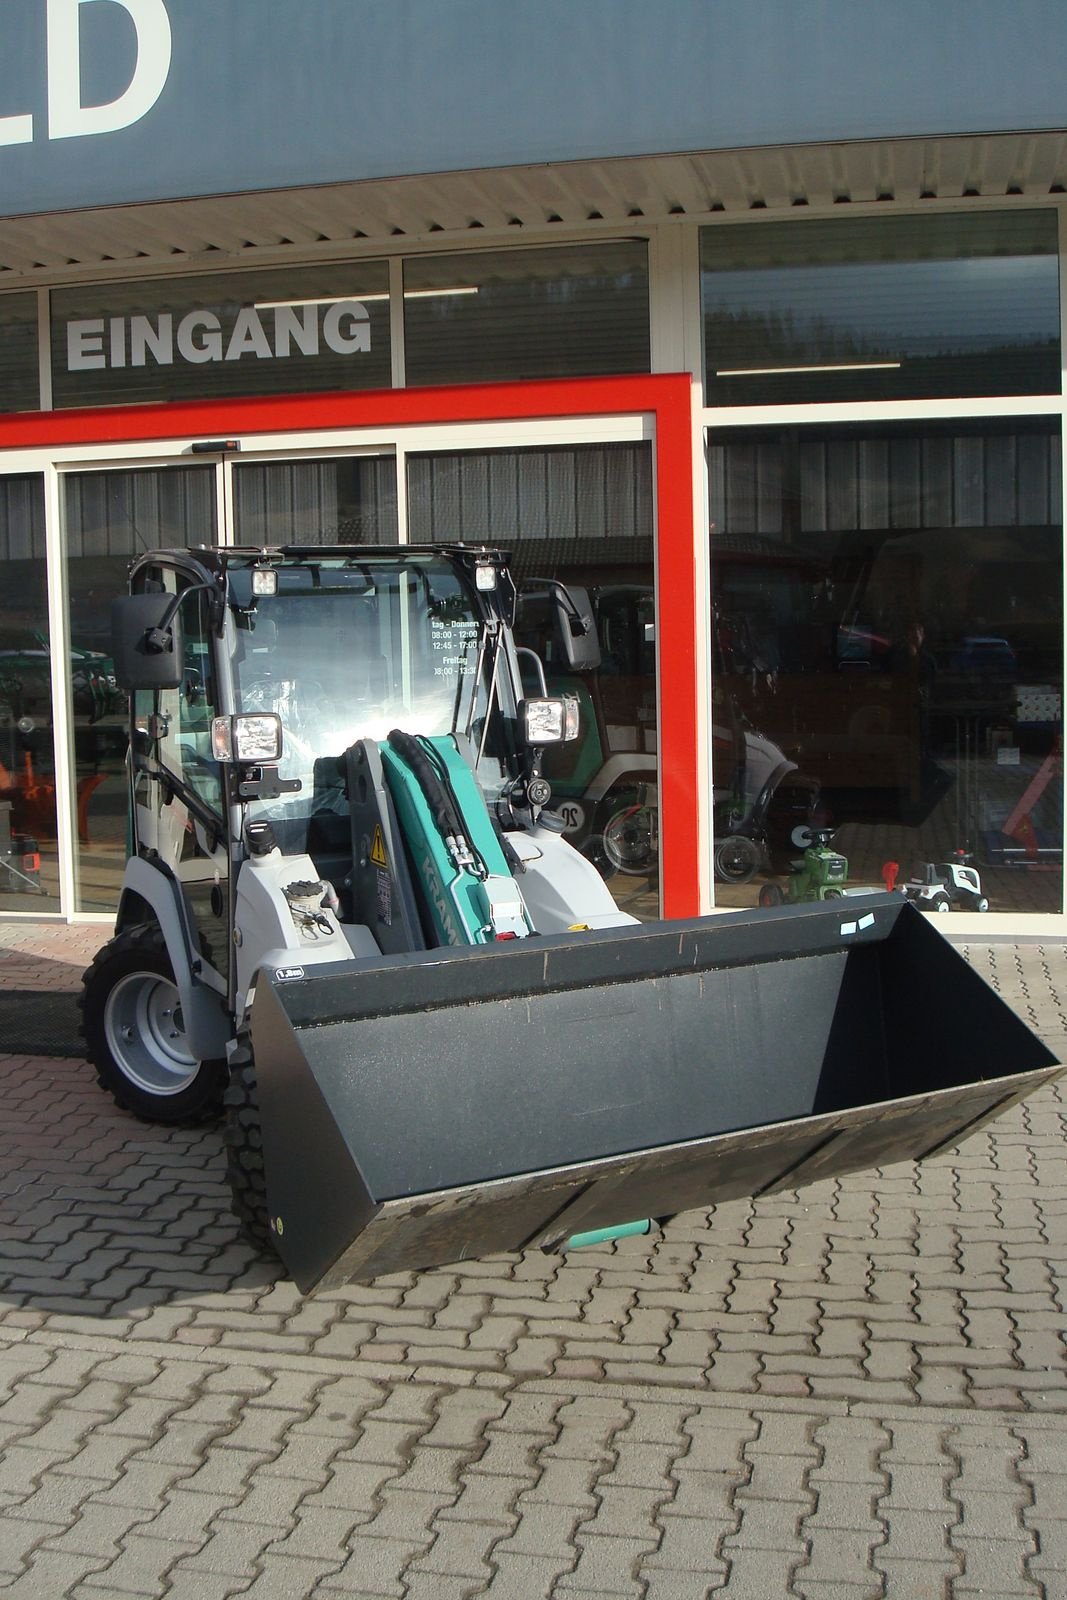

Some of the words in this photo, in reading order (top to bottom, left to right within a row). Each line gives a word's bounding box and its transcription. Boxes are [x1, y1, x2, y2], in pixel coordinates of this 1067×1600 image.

[0, 0, 172, 146] D
[67, 300, 371, 371] EINGANG
[459, 630, 477, 638] 12:00
[433, 641, 452, 649] 12:45
[459, 641, 477, 649] 17:00
[442, 656, 468, 665] Freitag
